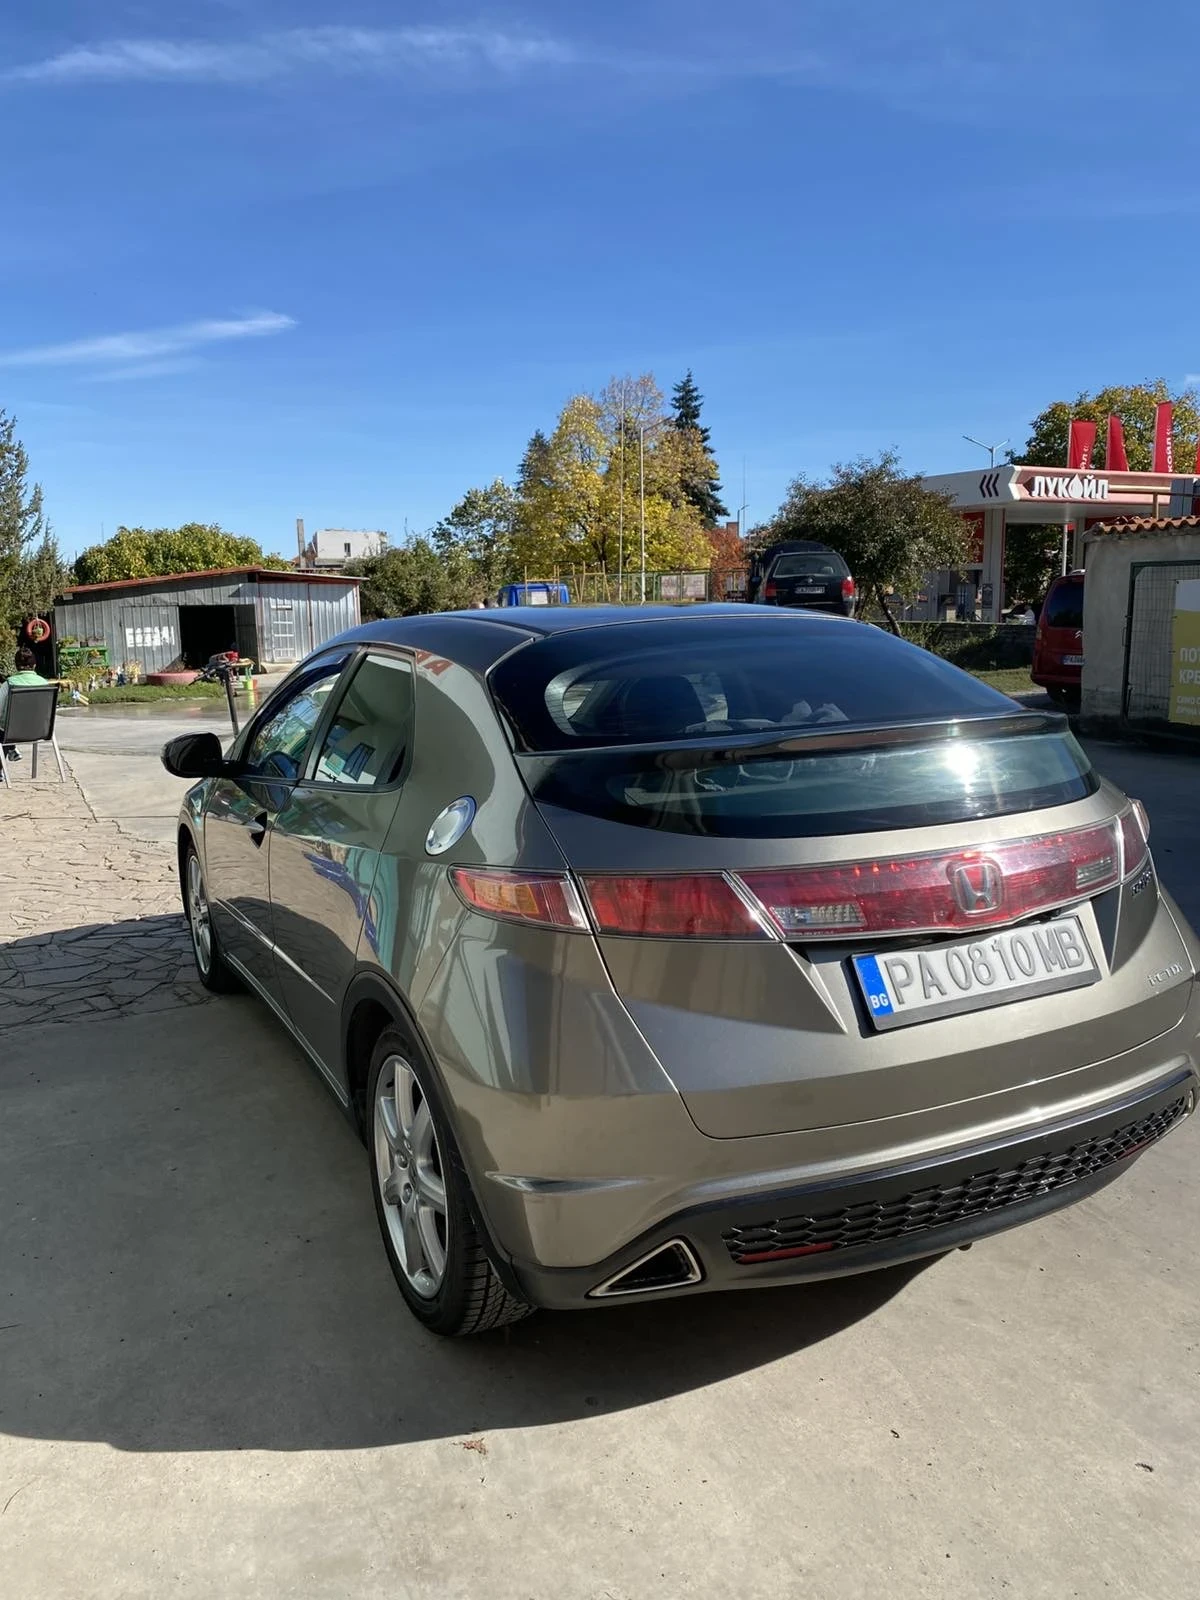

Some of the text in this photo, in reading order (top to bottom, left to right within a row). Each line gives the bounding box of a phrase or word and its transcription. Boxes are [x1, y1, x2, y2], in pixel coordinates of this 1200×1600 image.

[1032, 473, 1109, 499] ЛУКОЙЛ
[1180, 647, 1200, 663] ПО
[869, 991, 889, 1010] BG
